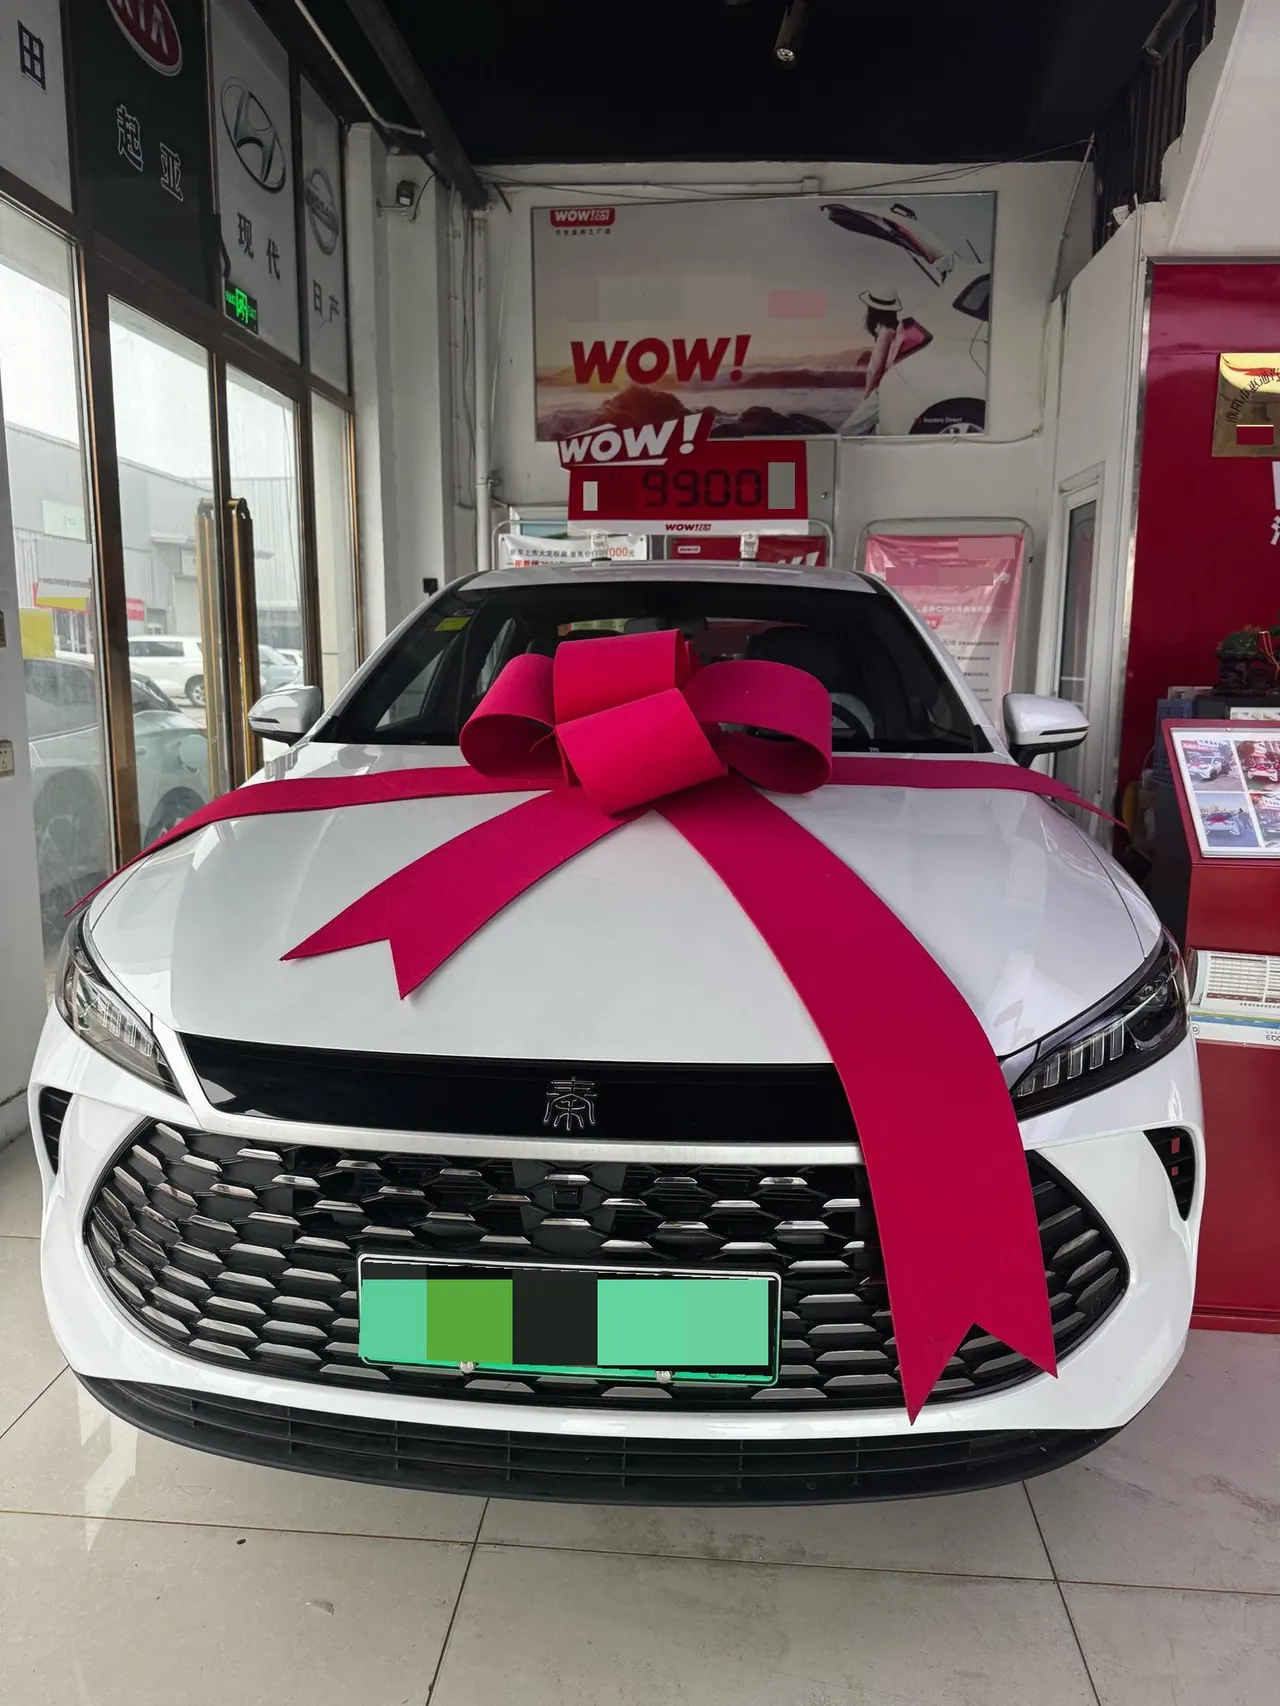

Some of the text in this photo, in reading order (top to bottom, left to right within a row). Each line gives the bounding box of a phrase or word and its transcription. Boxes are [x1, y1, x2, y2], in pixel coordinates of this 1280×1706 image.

[17, 19, 47, 92] 田
[116, 103, 185, 203] 起亚
[236, 211, 281, 281] 现代
[312, 278, 340, 324] 日产
[570, 334, 752, 385] WOW!
[559, 412, 703, 465] WOW!
[543, 1076, 598, 1131] 秦
